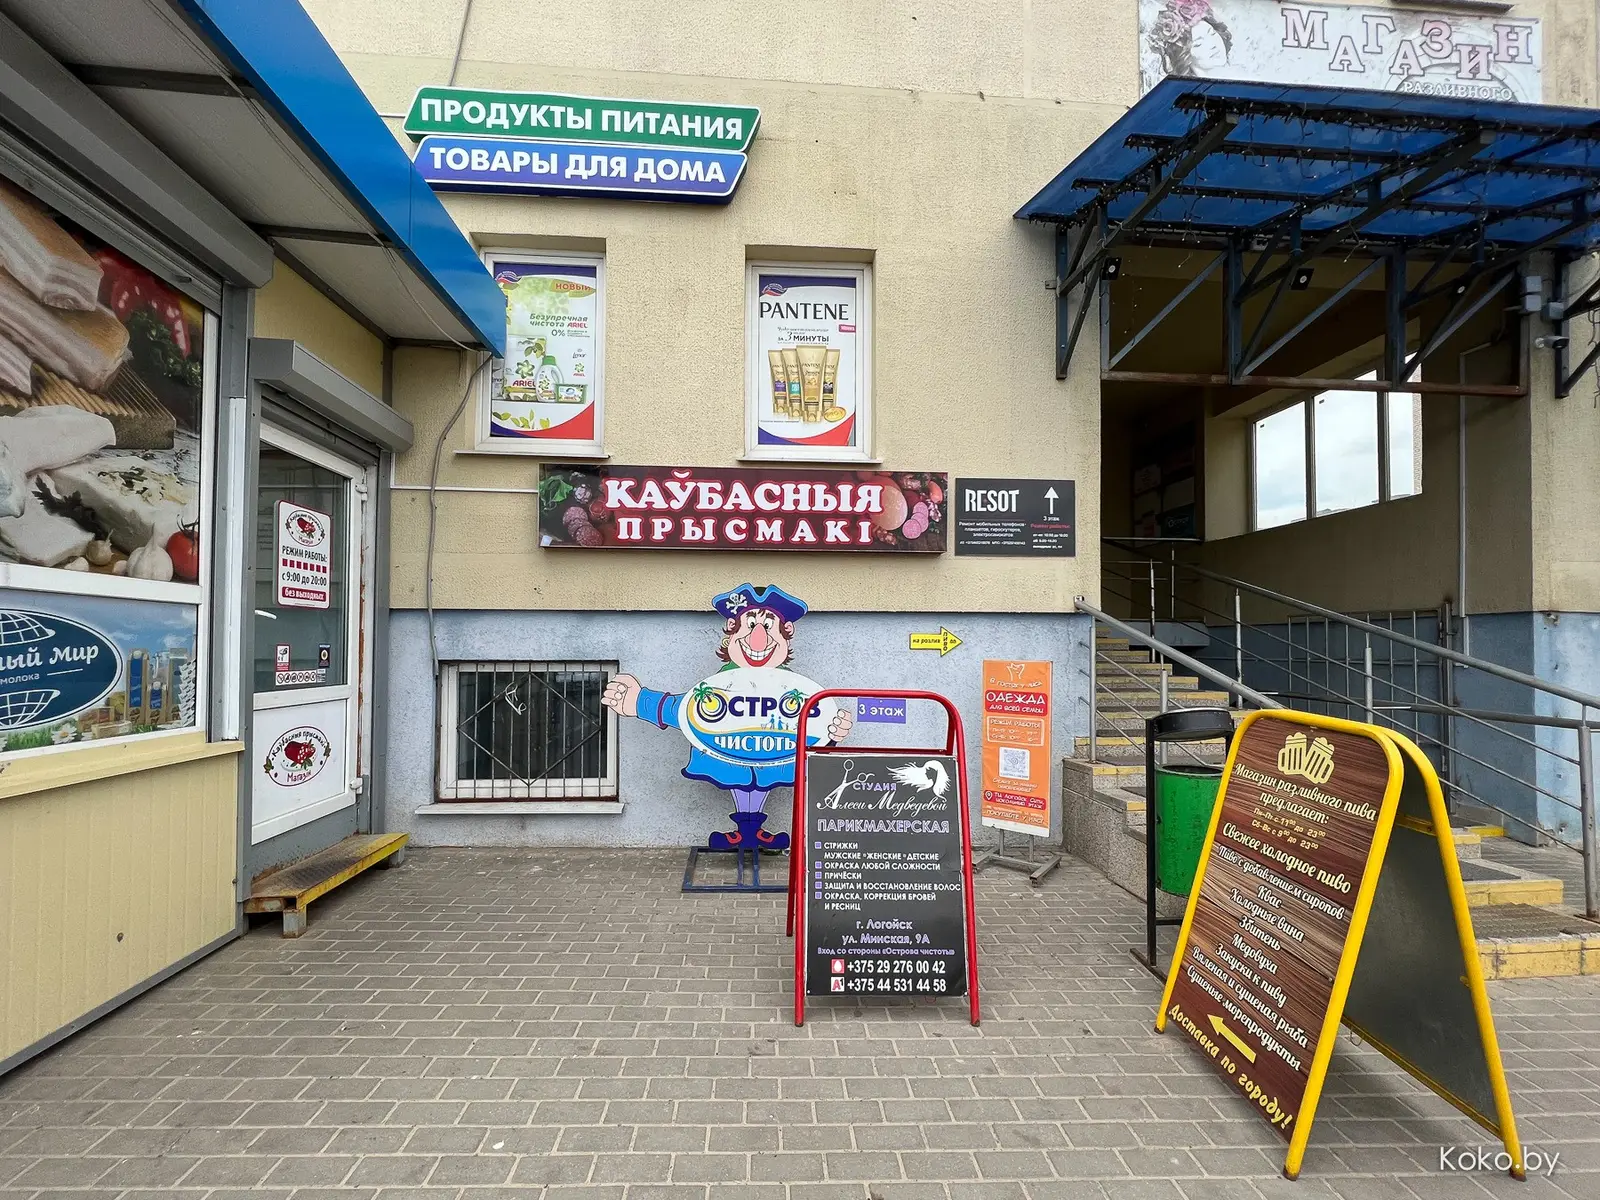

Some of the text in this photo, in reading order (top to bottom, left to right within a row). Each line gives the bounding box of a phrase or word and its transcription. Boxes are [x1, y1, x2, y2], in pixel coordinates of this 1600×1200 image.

[1280, 8, 1534, 80] МАГАЗИН
[1403, 81, 1513, 100] РАЗЛИВНОГО
[421, 98, 743, 140] ПРОДУКТЫ ПИТАНИЯ
[429, 147, 727, 184] ТОВАРЫ ДЛЯ ДОМА
[529, 313, 588, 322] Безупречная
[760, 301, 849, 321] PANTENE
[529, 320, 565, 328] чистота
[551, 329, 566, 337] 0%
[604, 469, 884, 514] КАЎБАСНЫЯ
[964, 488, 1020, 513] RESOT
[617, 517, 874, 544] ПРЫСМАКІ
[286, 571, 301, 583] 9:00
[301, 576, 310, 586] до
[310, 575, 327, 587] 20:00
[284, 587, 296, 597] без
[49, 645, 99, 665] Мир
[986, 691, 1046, 705] ОДЕЖДА
[858, 703, 905, 717] 3 этаж
[852, 782, 897, 791] СТУДИЯ
[1234, 763, 1377, 821] Магазин разливного пива
[816, 789, 948, 817] Алеси Медведевой
[1259, 791, 1330, 825] предлагает:
[817, 818, 950, 834] ПАРИКМАХЕРСКАЯ
[1293, 825, 1304, 833] до
[823, 842, 859, 850] СТРИЖКИ
[1287, 836, 1297, 844] до
[823, 852, 940, 861] МУЖСКИЕ ЖЕНСКИЕ ДЕТСКИЕ
[1222, 822, 1351, 894] Свежее холодное пиво
[824, 861, 941, 871] ОКРАСКА ЛЮБОЙ СЛОЖНОСТИ
[824, 871, 862, 880] ПРИЧЁСКИ
[1218, 846, 1346, 920] Пиво с добавлением сиропов
[824, 882, 855, 890] ЗАЩИТА
[863, 883, 933, 891] ВОССТАНОВЛЕНИЕ
[933, 883, 961, 891] ВОЛОС
[863, 892, 907, 902] КОРРЕКЦИЯ
[908, 892, 937, 901] БРОВЕЙ
[1256, 885, 1283, 909] Квас
[824, 902, 861, 912] И РЕСНИЦ
[1230, 887, 1305, 942] Холодные вина
[856, 918, 913, 930] г. Логойск
[842, 933, 930, 946] ул. Минская, 9А
[1238, 915, 1282, 951] Збитень
[817, 947, 835, 956] Вход
[848, 948, 881, 956] стороны
[1231, 933, 1279, 975] Медовуха
[847, 960, 946, 974] +375 29 276 00 42
[1215, 943, 1288, 1008] Закуски к пиву
[847, 978, 875, 991] +375
[877, 978, 891, 991] 44
[893, 978, 914, 992] 531
[916, 979, 930, 992] 44
[932, 979, 947, 992] 58
[1192, 945, 1309, 1048] Вяленая и сушеная рыба
[1187, 964, 1302, 1071] Сушеные морепродукты
[1168, 1004, 1294, 1130] Доставка по городу!
